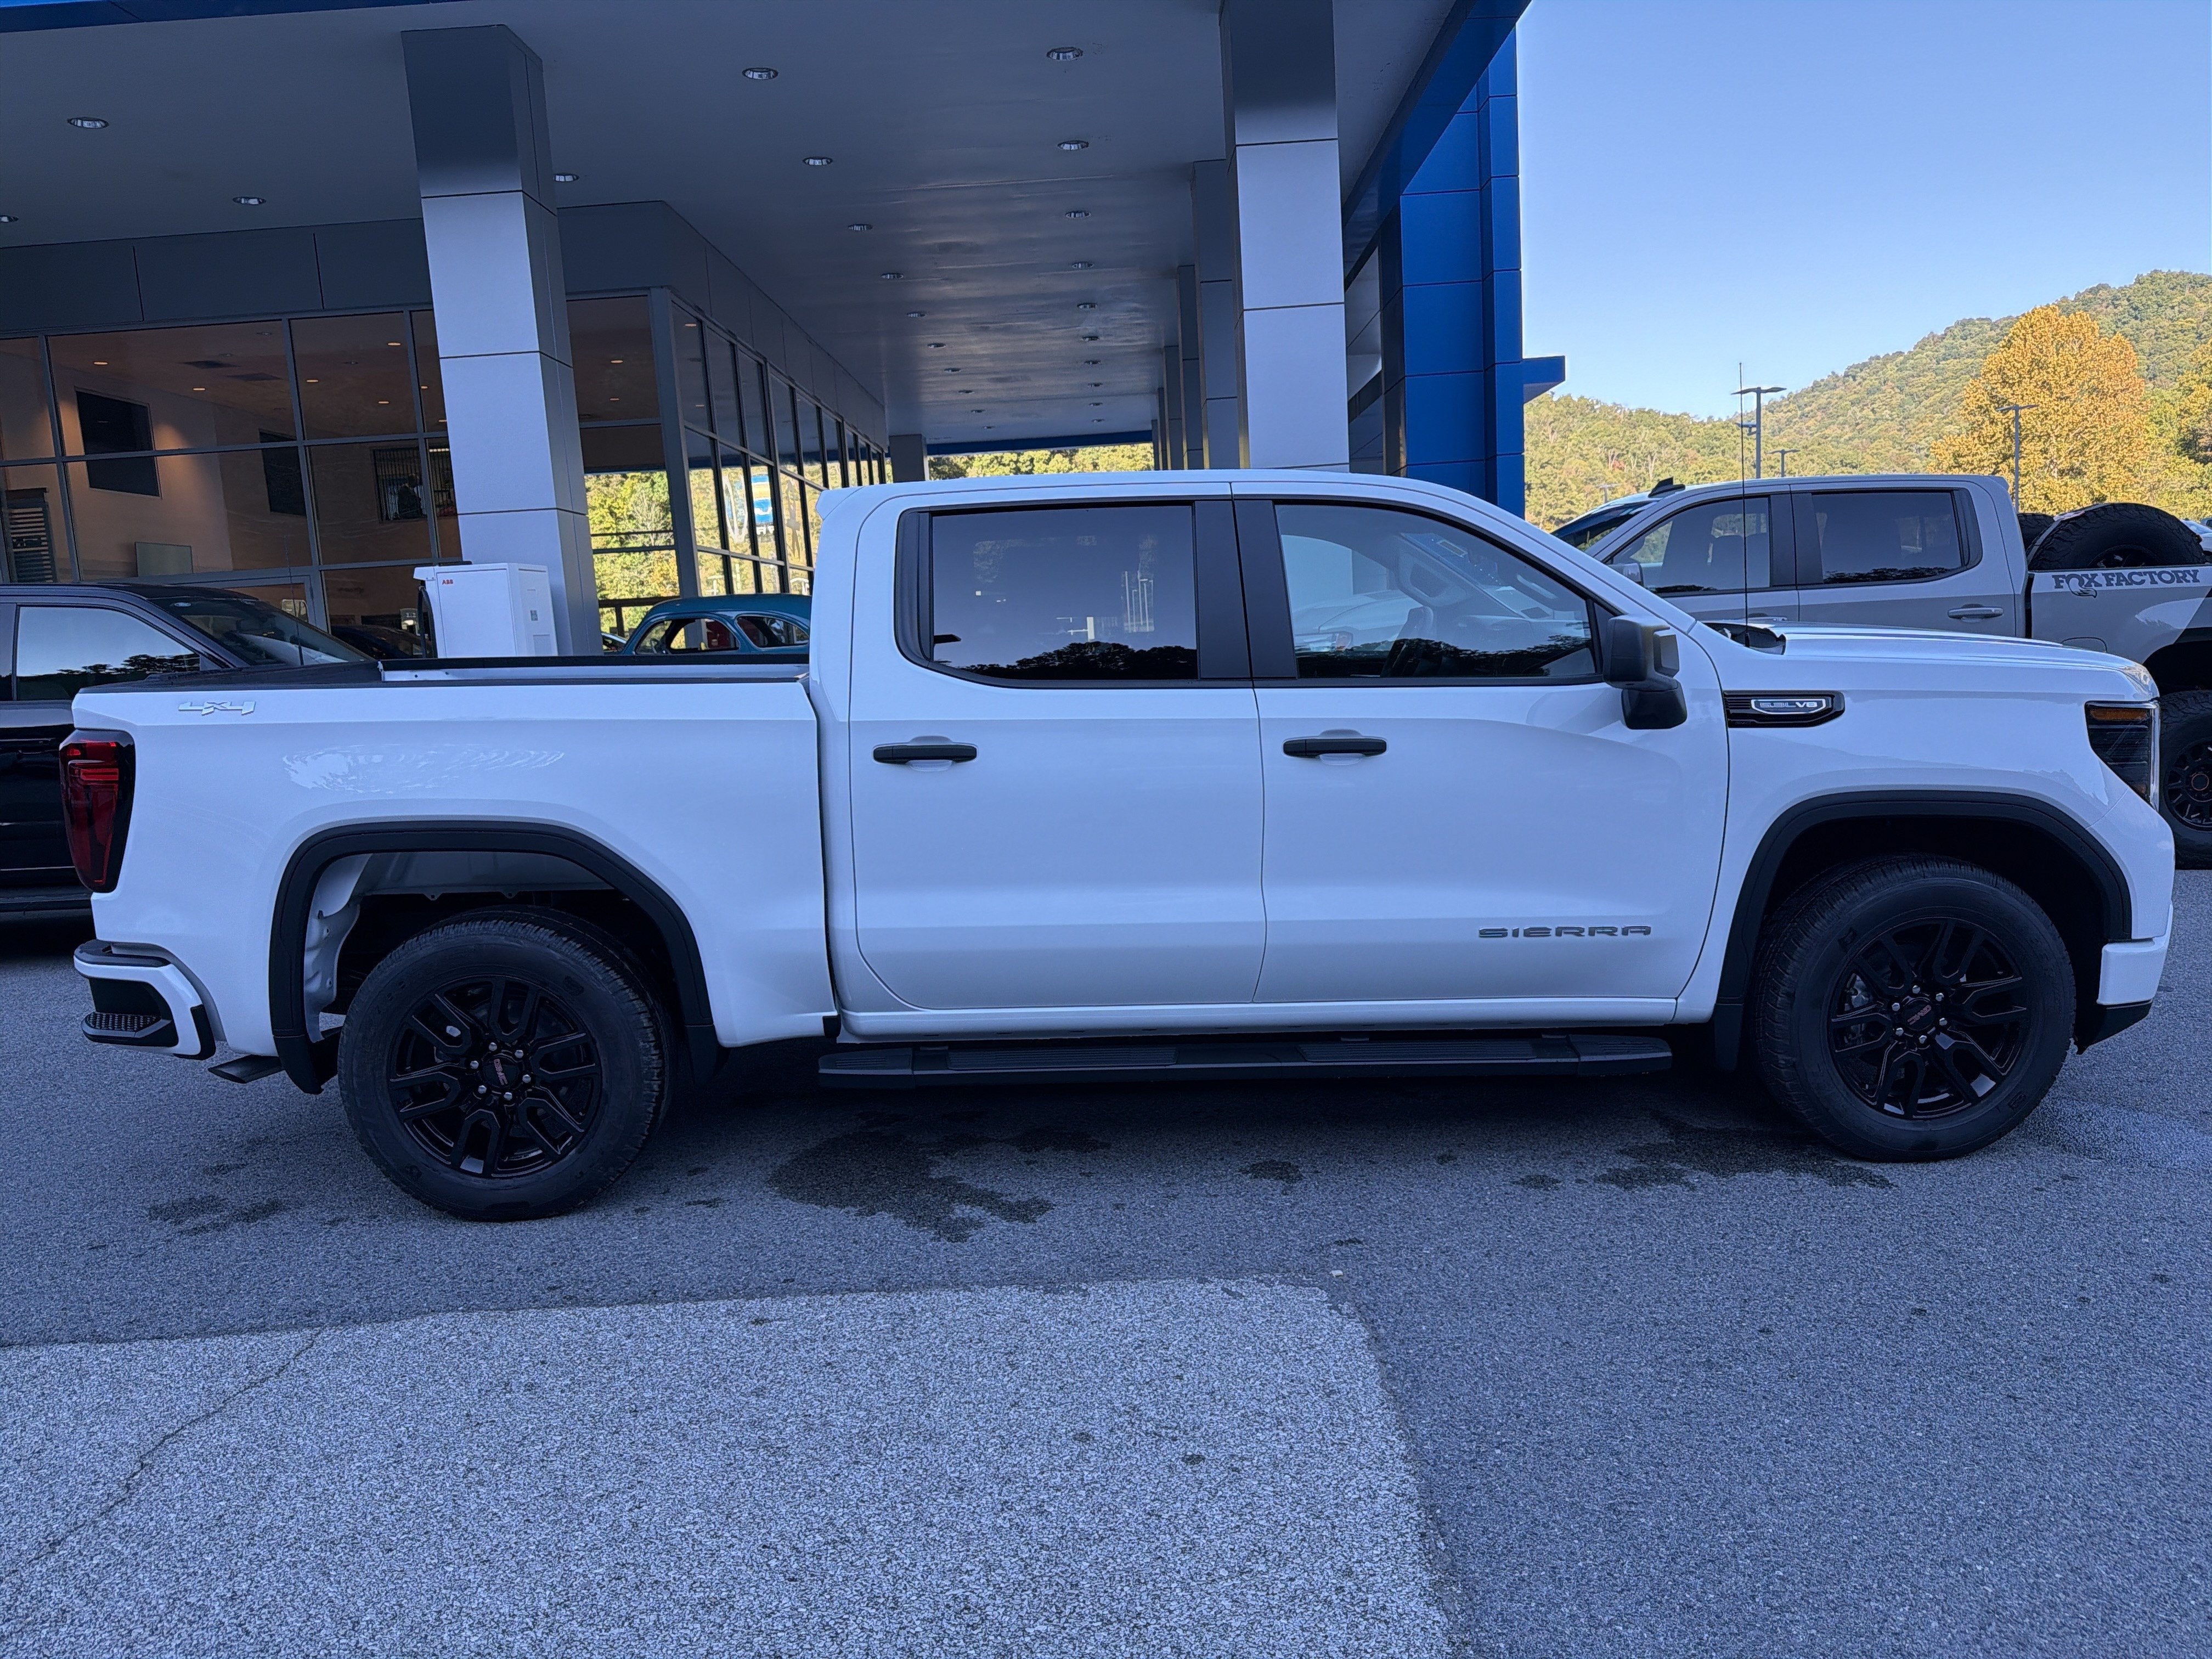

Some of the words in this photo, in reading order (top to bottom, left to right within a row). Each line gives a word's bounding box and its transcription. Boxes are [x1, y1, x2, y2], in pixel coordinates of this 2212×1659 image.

[2052, 573, 2102, 597] FOX
[2102, 569, 2200, 586] FACTORY
[1479, 926, 1651, 938] SIERRA
[1907, 1005, 1931, 1025] GMC
[494, 1058, 508, 1086] GMC
